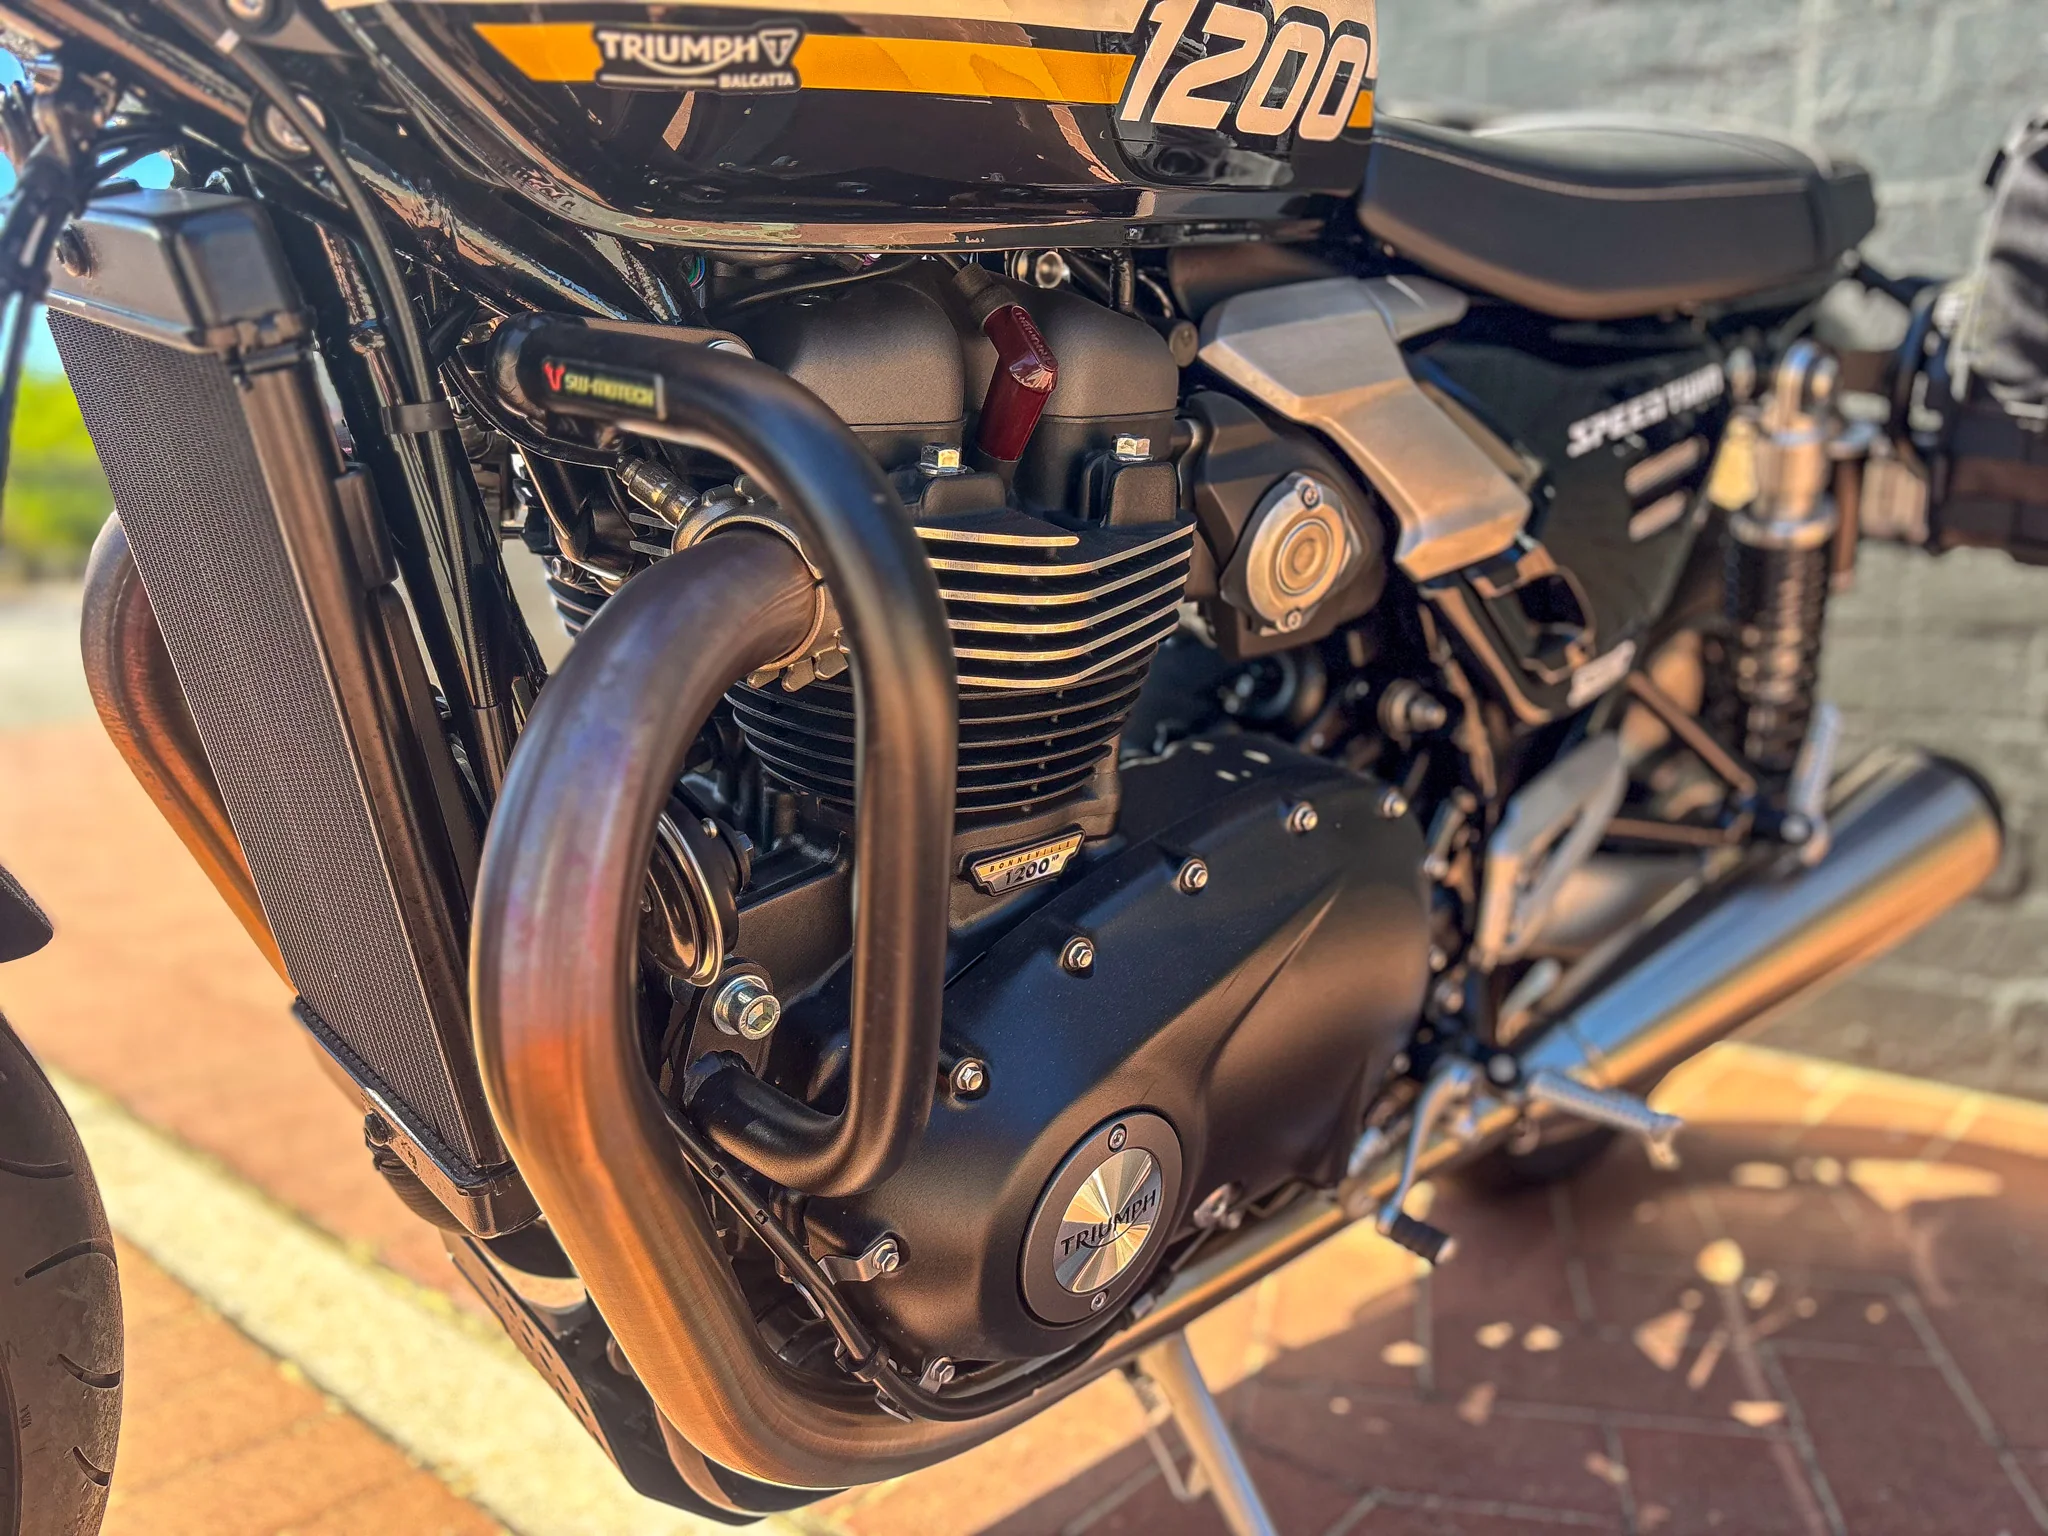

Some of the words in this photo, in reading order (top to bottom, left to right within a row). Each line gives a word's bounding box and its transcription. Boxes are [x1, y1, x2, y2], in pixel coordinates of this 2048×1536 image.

[597, 32, 758, 74] TRIUMPH
[1119, 0, 1368, 142] 1200
[718, 72, 795, 89] BALCATTA
[989, 840, 1071, 873] BONNEVILLE
[1005, 857, 1050, 886] 1200
[1060, 1188, 1157, 1257] TRIUMPH
